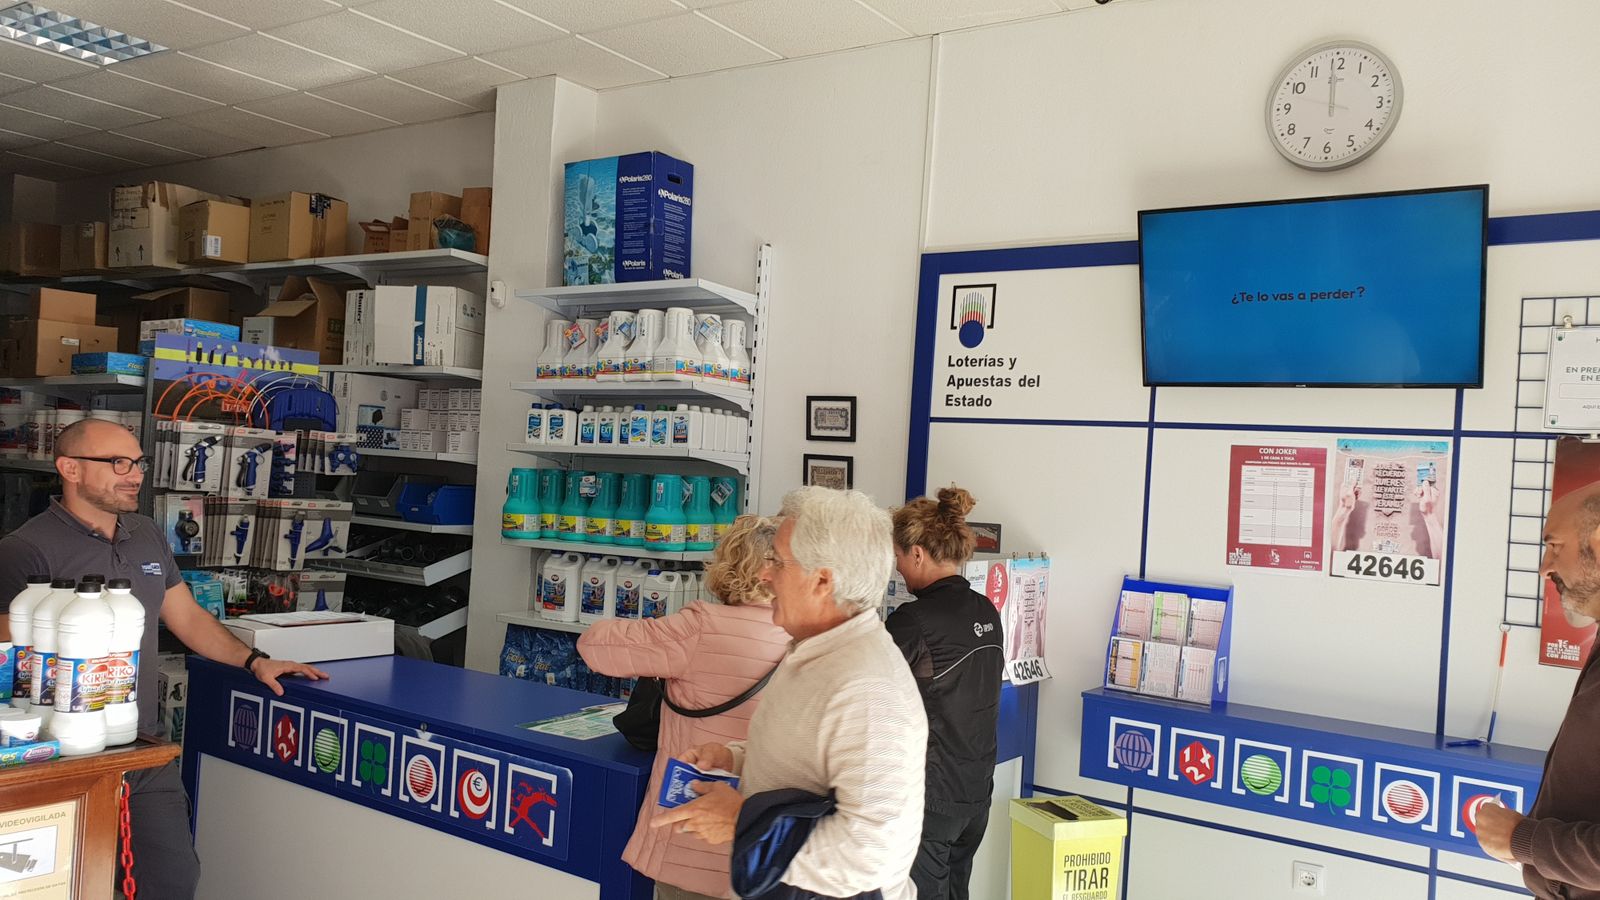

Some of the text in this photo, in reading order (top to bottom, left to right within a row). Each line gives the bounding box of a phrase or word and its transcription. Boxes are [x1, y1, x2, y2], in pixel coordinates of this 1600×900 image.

[1310, 65, 1319, 78] 11
[1358, 61, 1363, 75] 1
[1292, 81, 1306, 95] 10
[1370, 74, 1380, 88] 2
[1283, 102, 1292, 115] 9
[1375, 95, 1384, 109] 3
[1286, 122, 1296, 136] 8
[1364, 118, 1374, 131] 4
[1303, 136, 1311, 149] 7
[1322, 141, 1332, 154] 6
[1346, 134, 1355, 148] 5
[1231, 286, 1366, 305] ¿Te lo vas a perder?
[947, 354, 1017, 370] Loterías y
[1566, 366, 1600, 374] EN PRE
[946, 374, 1041, 390] Apuestas del
[1581, 374, 1593, 382] EN
[945, 394, 993, 407] Estado
[583, 426, 593, 434] EXT
[601, 426, 612, 434] EXT
[1347, 554, 1425, 581] 42646
[1013, 659, 1043, 680] 42646
[1064, 851, 1111, 868] PROHIBIDO
[1064, 867, 1109, 892] TIRAR
